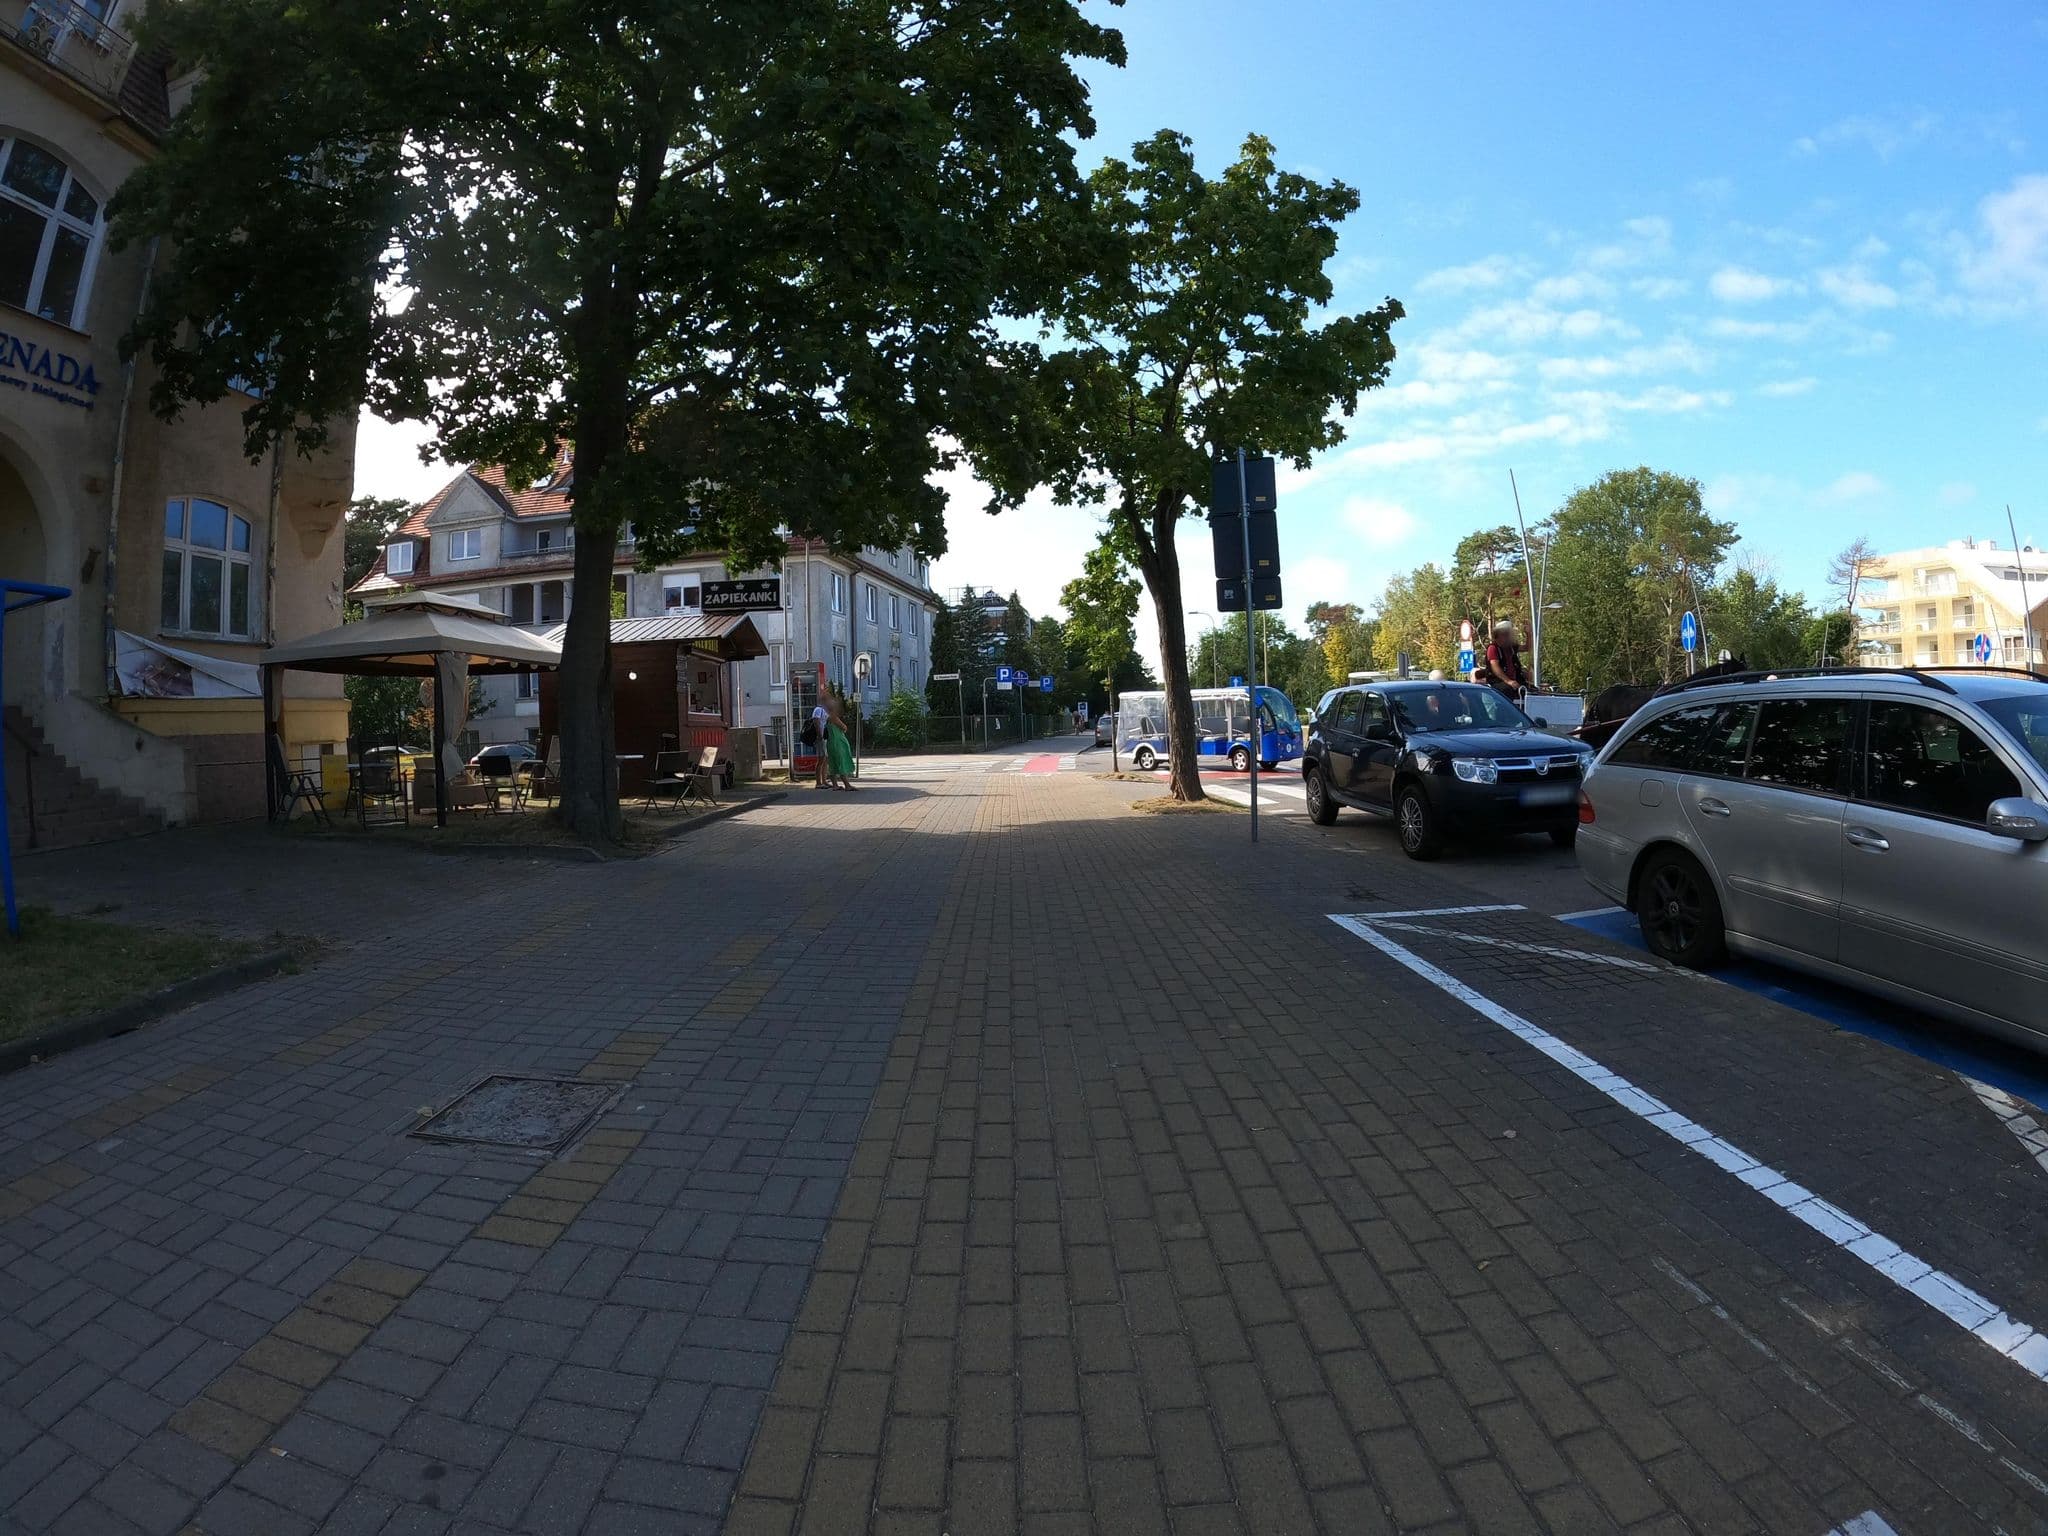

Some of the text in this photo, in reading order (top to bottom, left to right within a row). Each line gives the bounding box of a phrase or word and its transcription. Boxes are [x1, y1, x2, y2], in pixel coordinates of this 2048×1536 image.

[704, 591, 777, 605] ZAPIEKANKI
[1000, 668, 1009, 680] P
[1043, 678, 1050, 688] P
